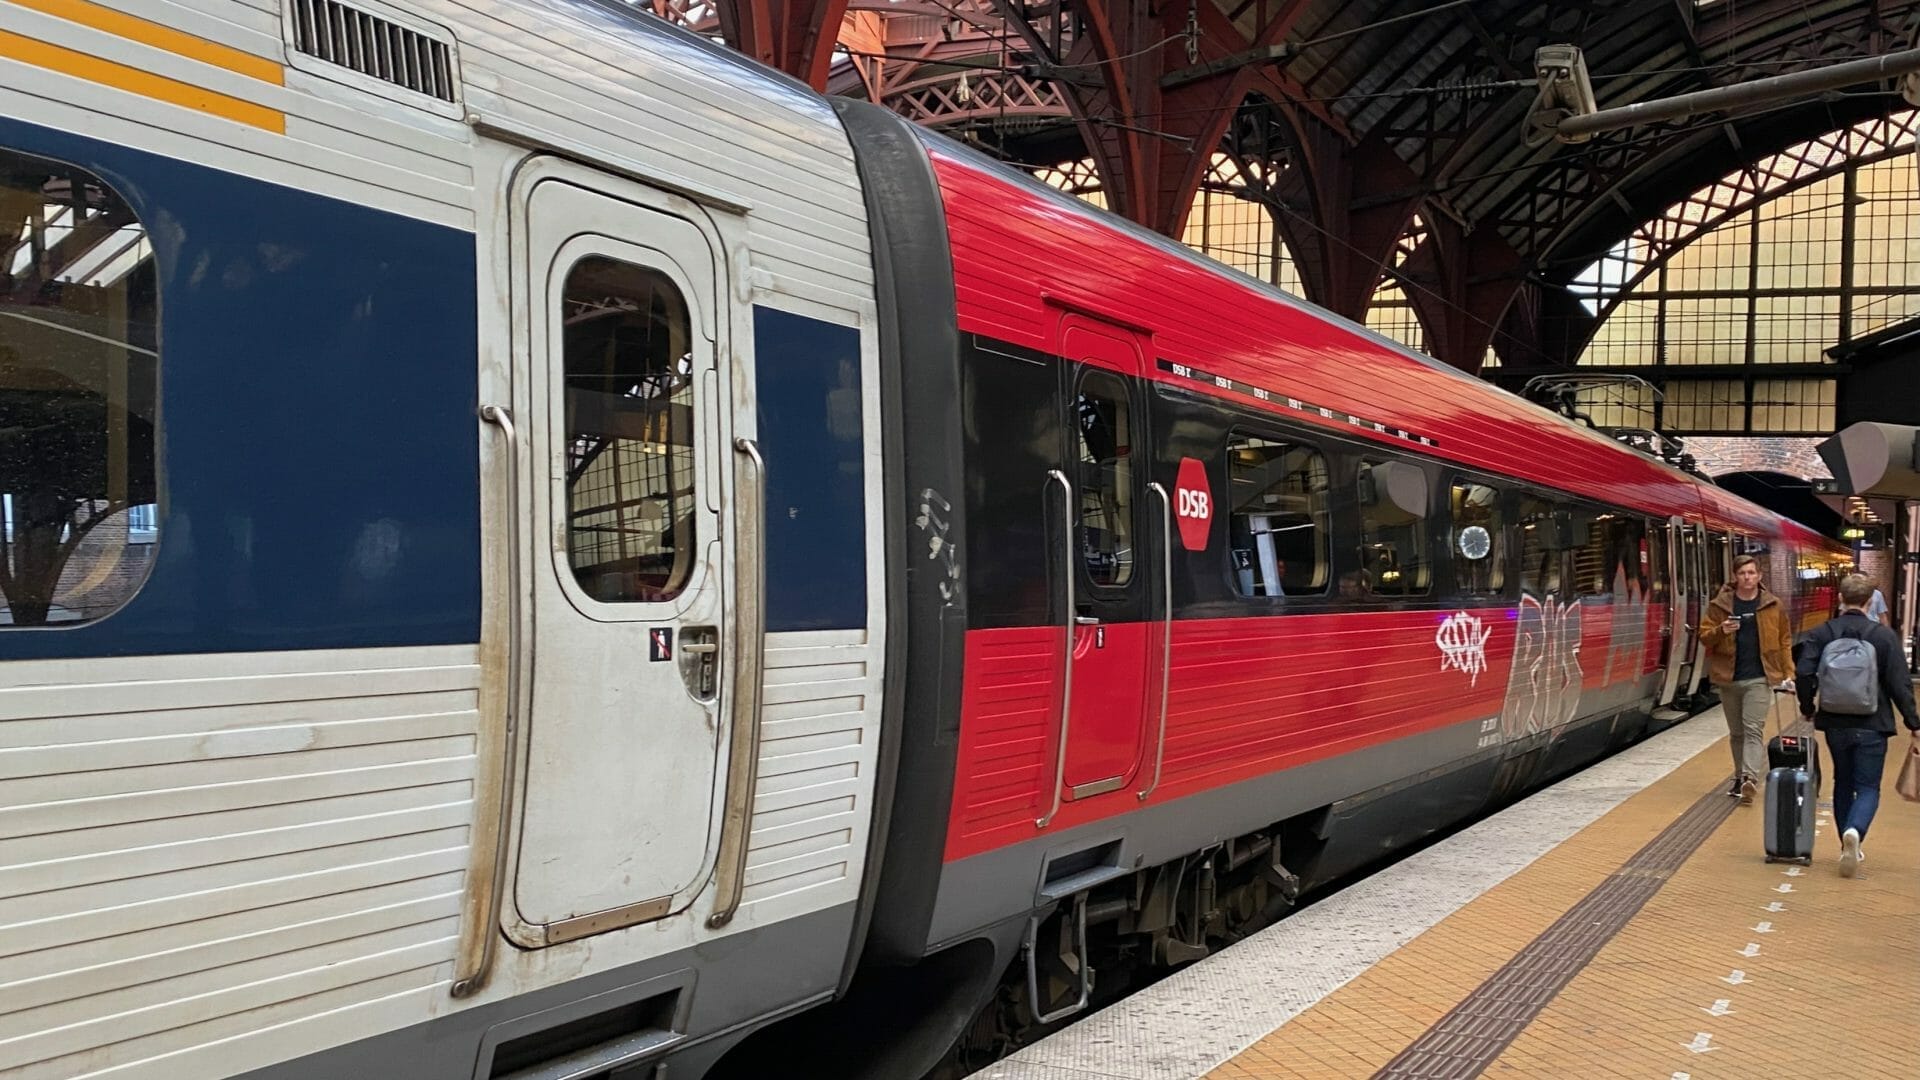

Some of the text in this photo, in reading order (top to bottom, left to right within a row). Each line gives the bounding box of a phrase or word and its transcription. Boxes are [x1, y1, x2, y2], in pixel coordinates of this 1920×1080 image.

[1172, 363, 1185, 376] DSB
[1215, 376, 1227, 388] DSB
[1178, 487, 1209, 519] DSB
